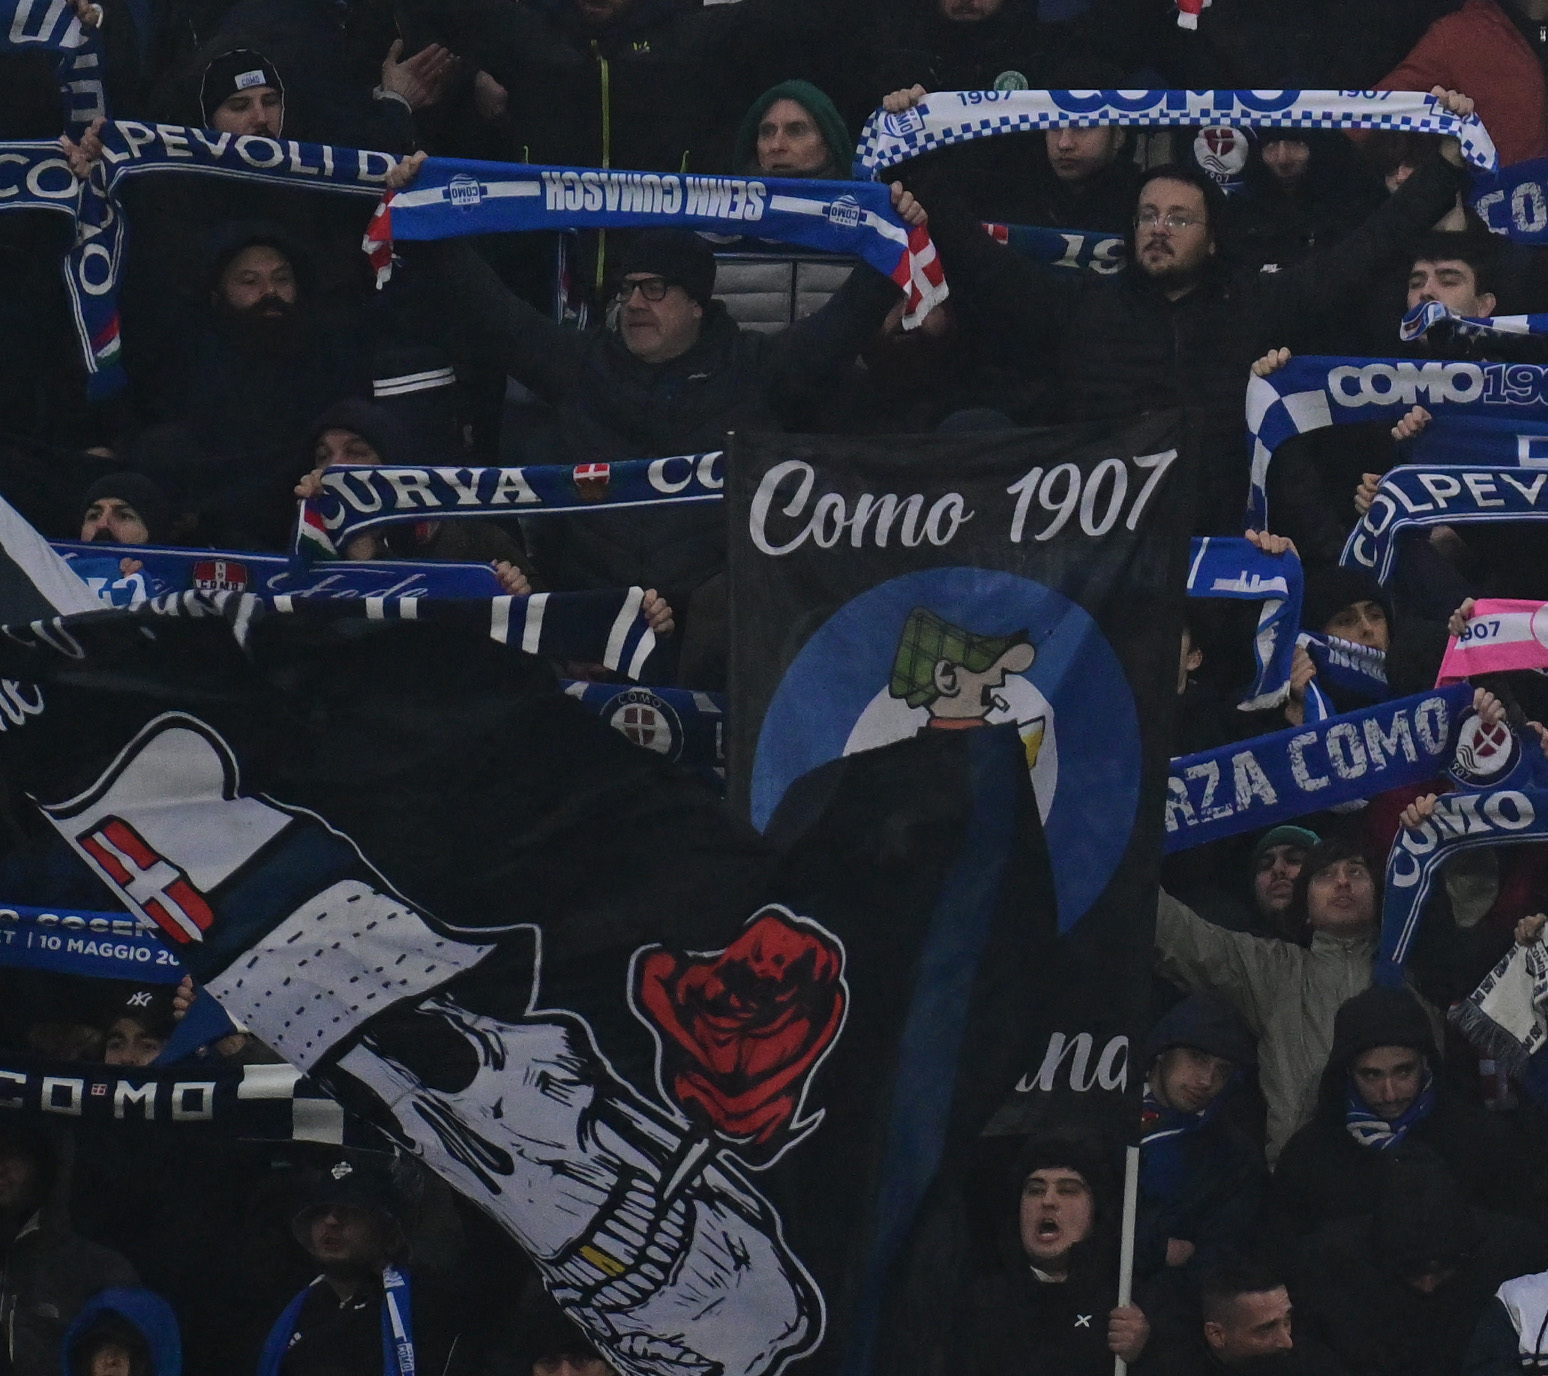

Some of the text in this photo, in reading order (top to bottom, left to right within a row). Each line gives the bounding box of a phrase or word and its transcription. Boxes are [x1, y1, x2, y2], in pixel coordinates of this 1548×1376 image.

[541, 171, 766, 221] SEMM CUMASCH
[319, 463, 543, 532] CURVA
[749, 448, 1178, 556] Como 1907
[1291, 697, 1451, 794] COMO
[1390, 789, 1537, 889] COMO
[39, 935, 152, 963] 10 MAGGIO
